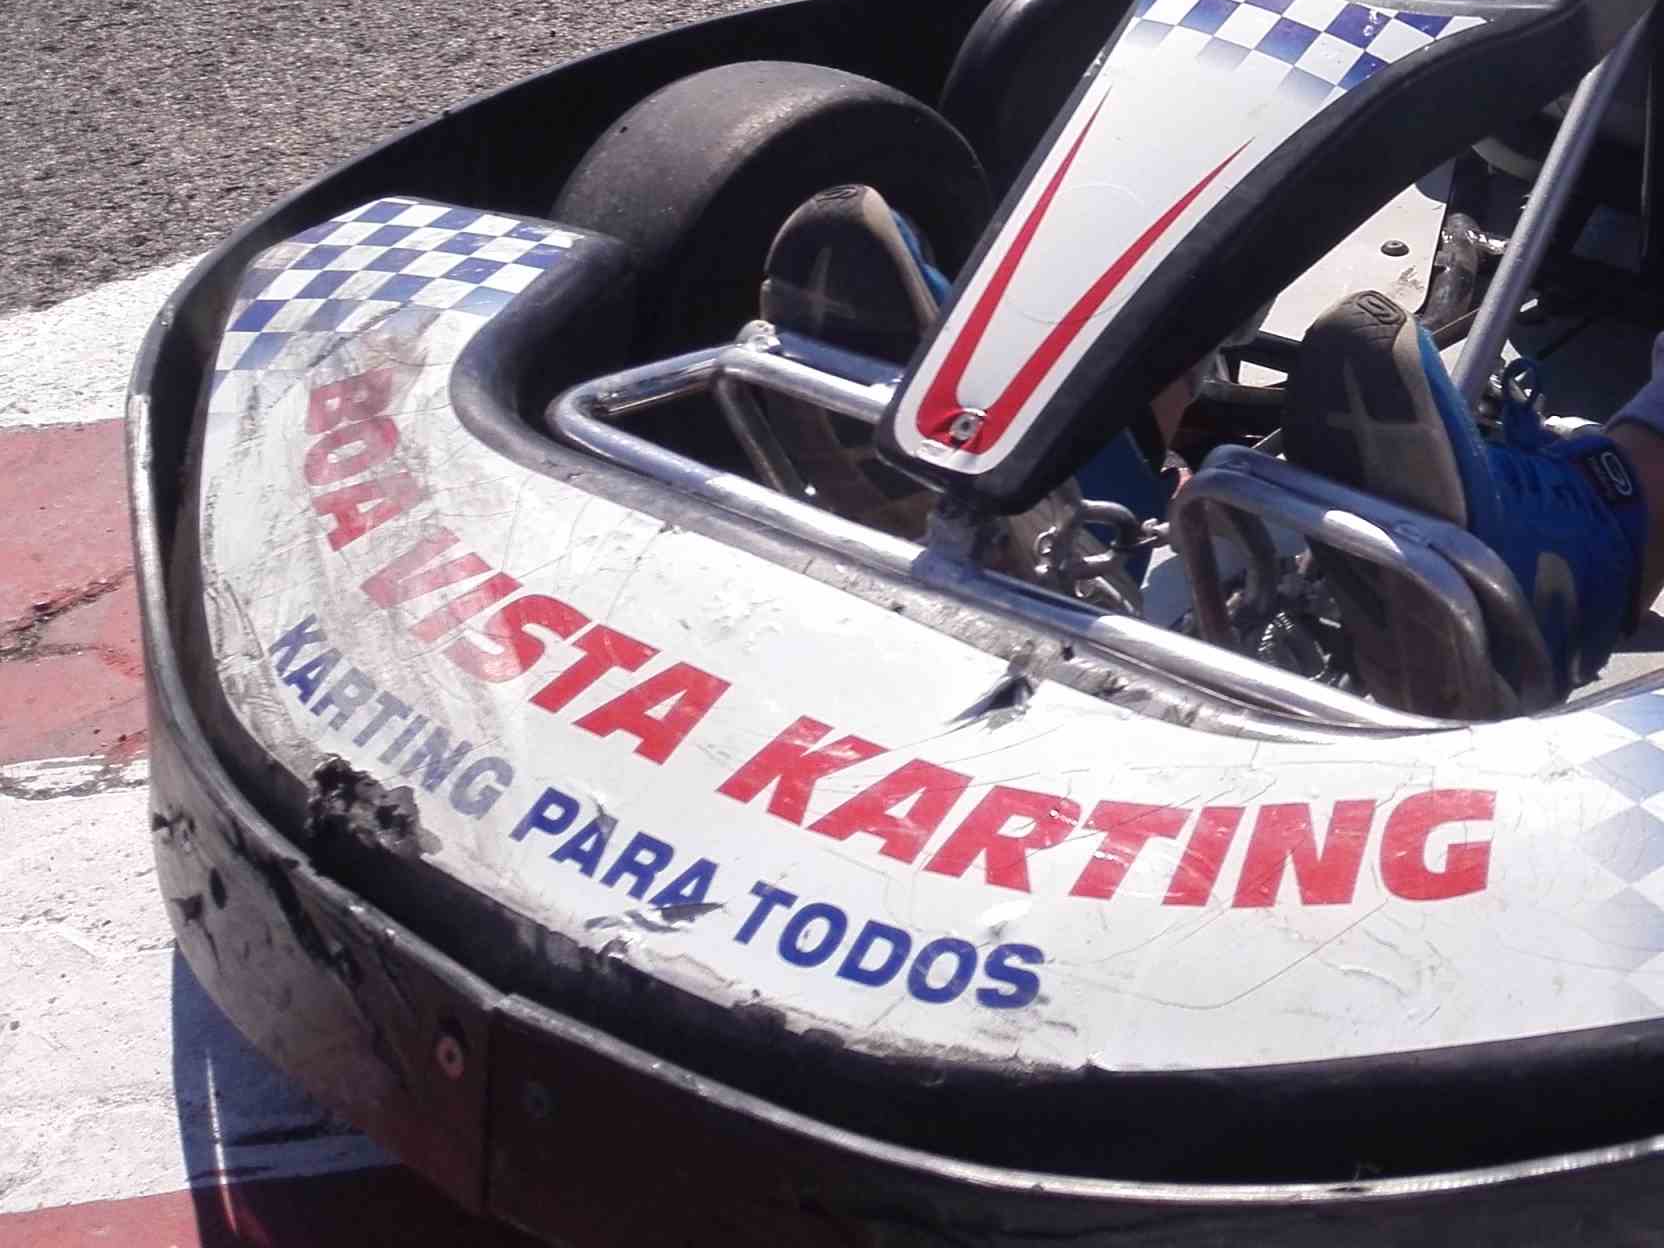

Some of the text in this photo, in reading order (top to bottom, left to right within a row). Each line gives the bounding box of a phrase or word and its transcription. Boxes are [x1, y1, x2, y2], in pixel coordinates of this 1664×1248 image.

[268, 614, 1046, 1010] KARTING PARA TODOS
[304, 366, 1497, 909] BOA VISTA KARTING
